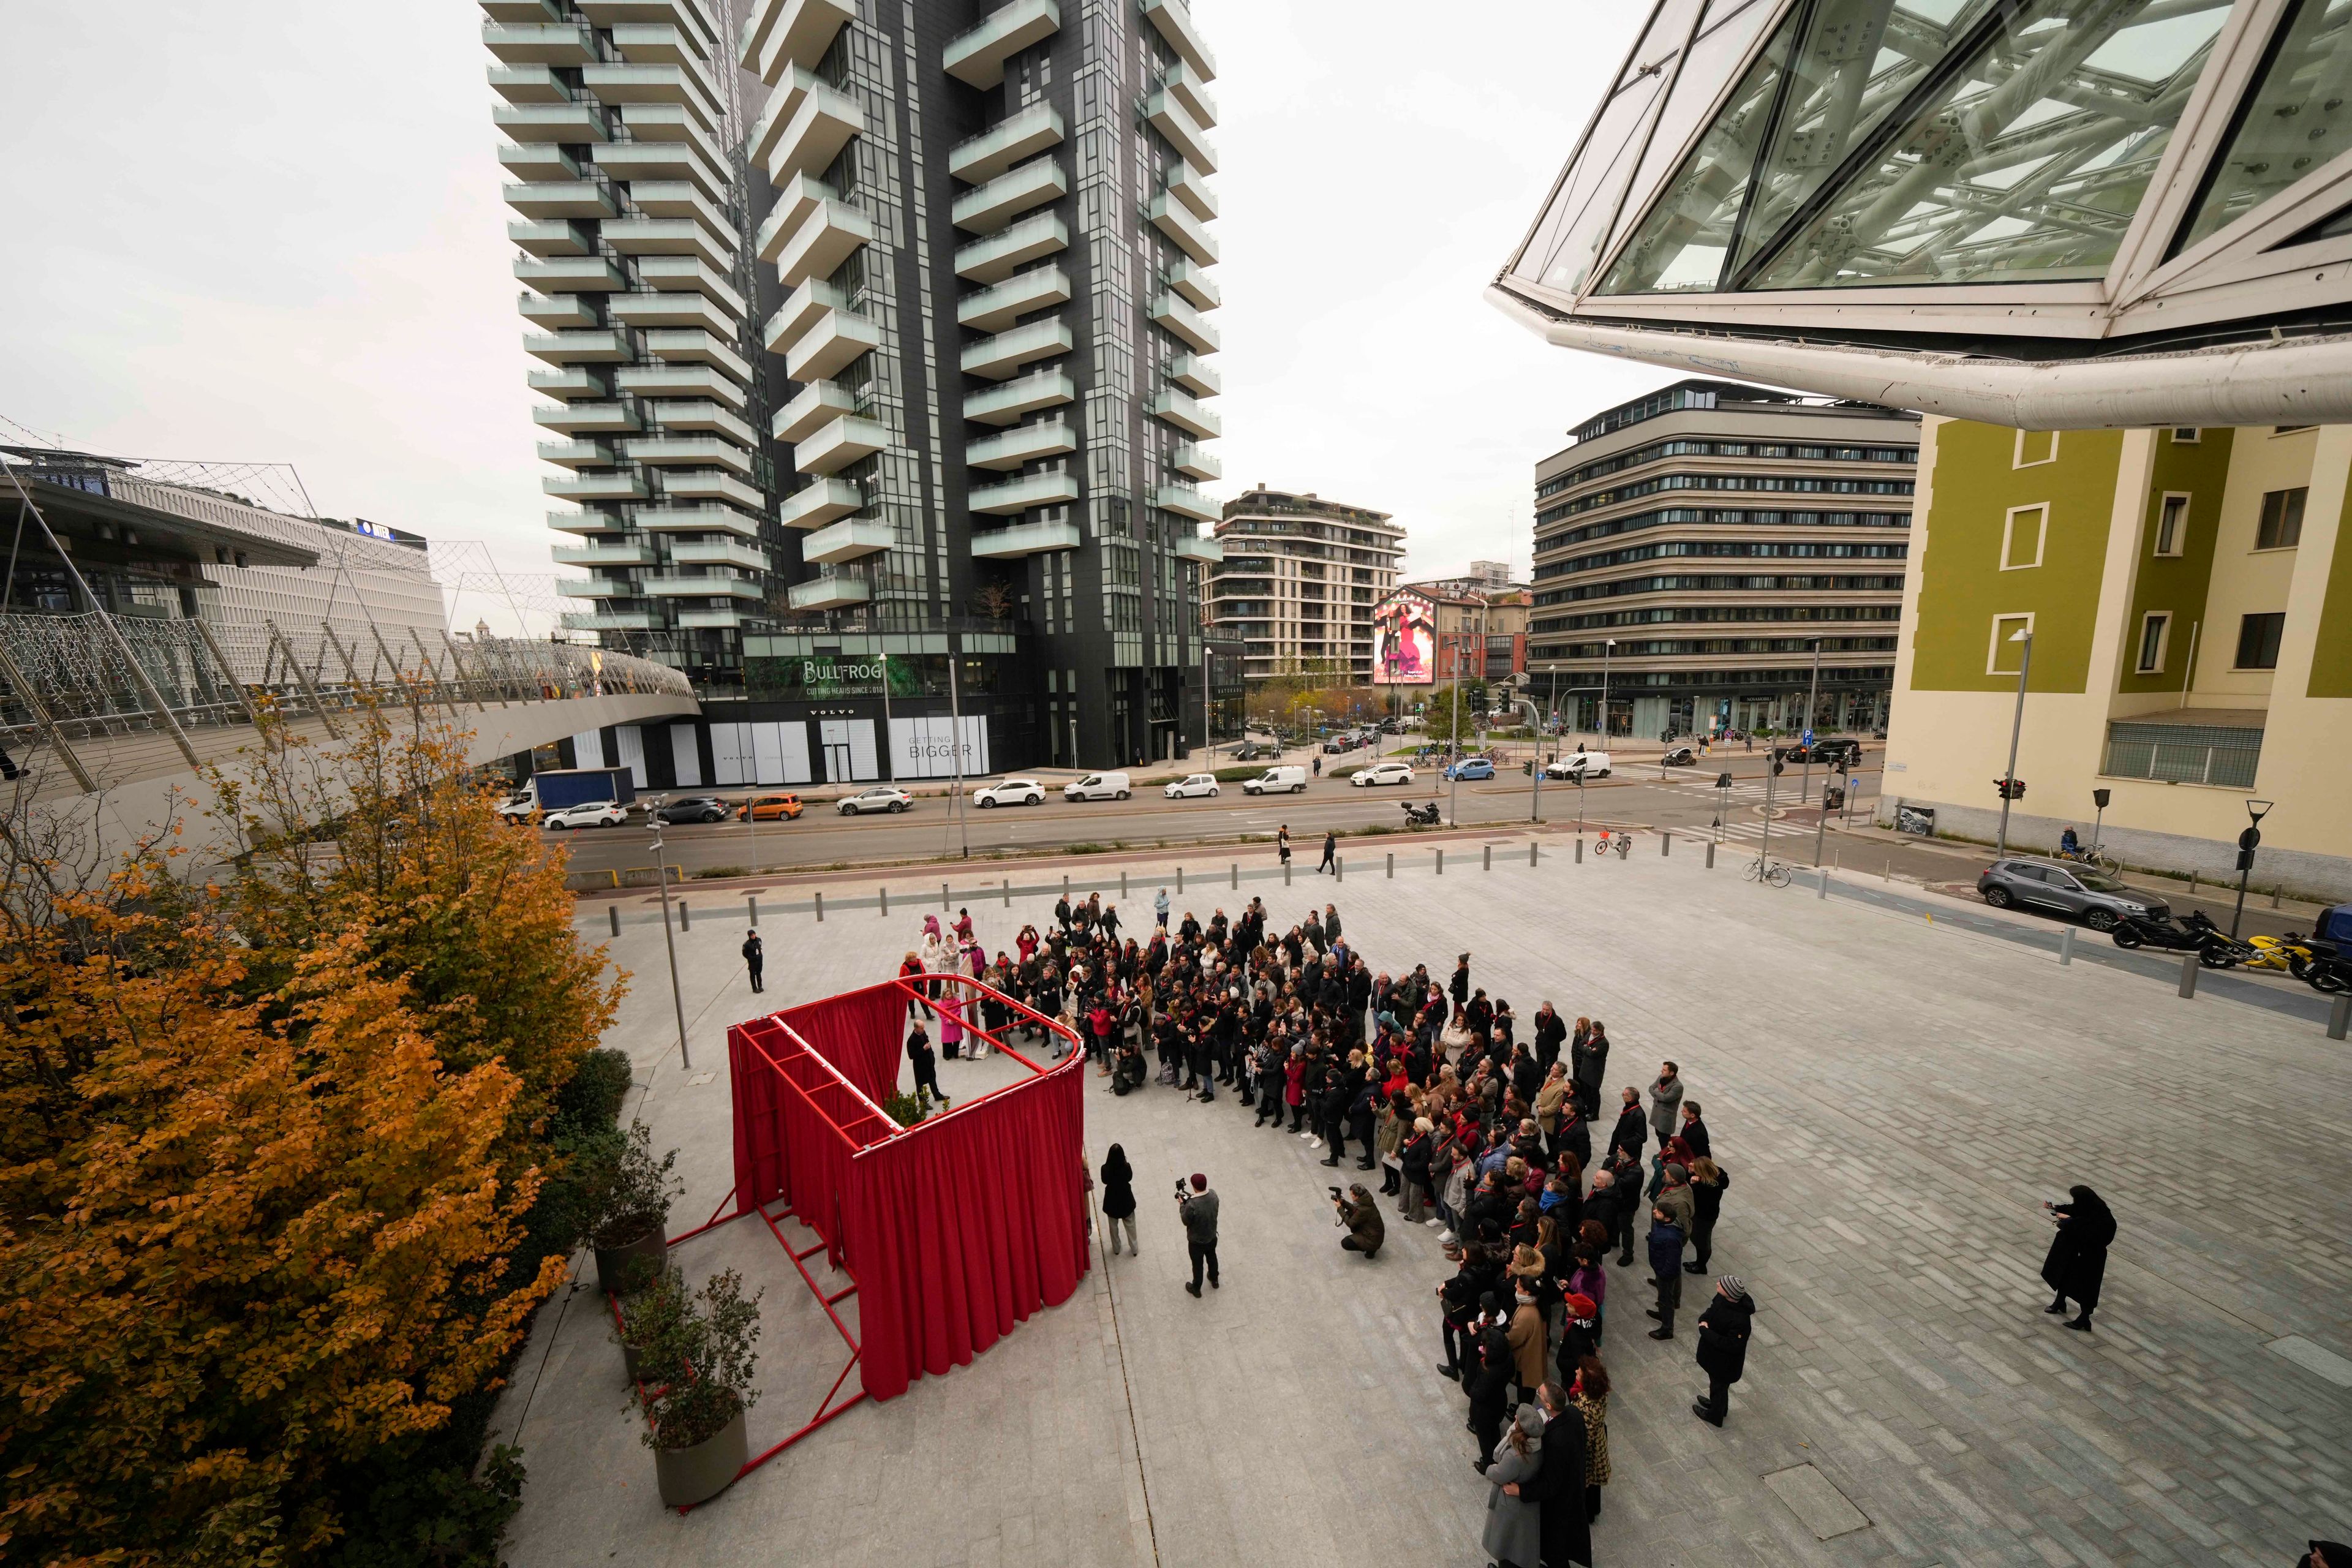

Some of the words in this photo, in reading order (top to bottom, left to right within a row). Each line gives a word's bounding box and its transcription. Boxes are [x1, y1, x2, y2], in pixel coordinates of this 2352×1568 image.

[372, 523, 391, 540] INTER
[803, 662, 883, 683] BULLFROG
[1804, 729, 1811, 738] P
[910, 745, 972, 758] BIGGER
